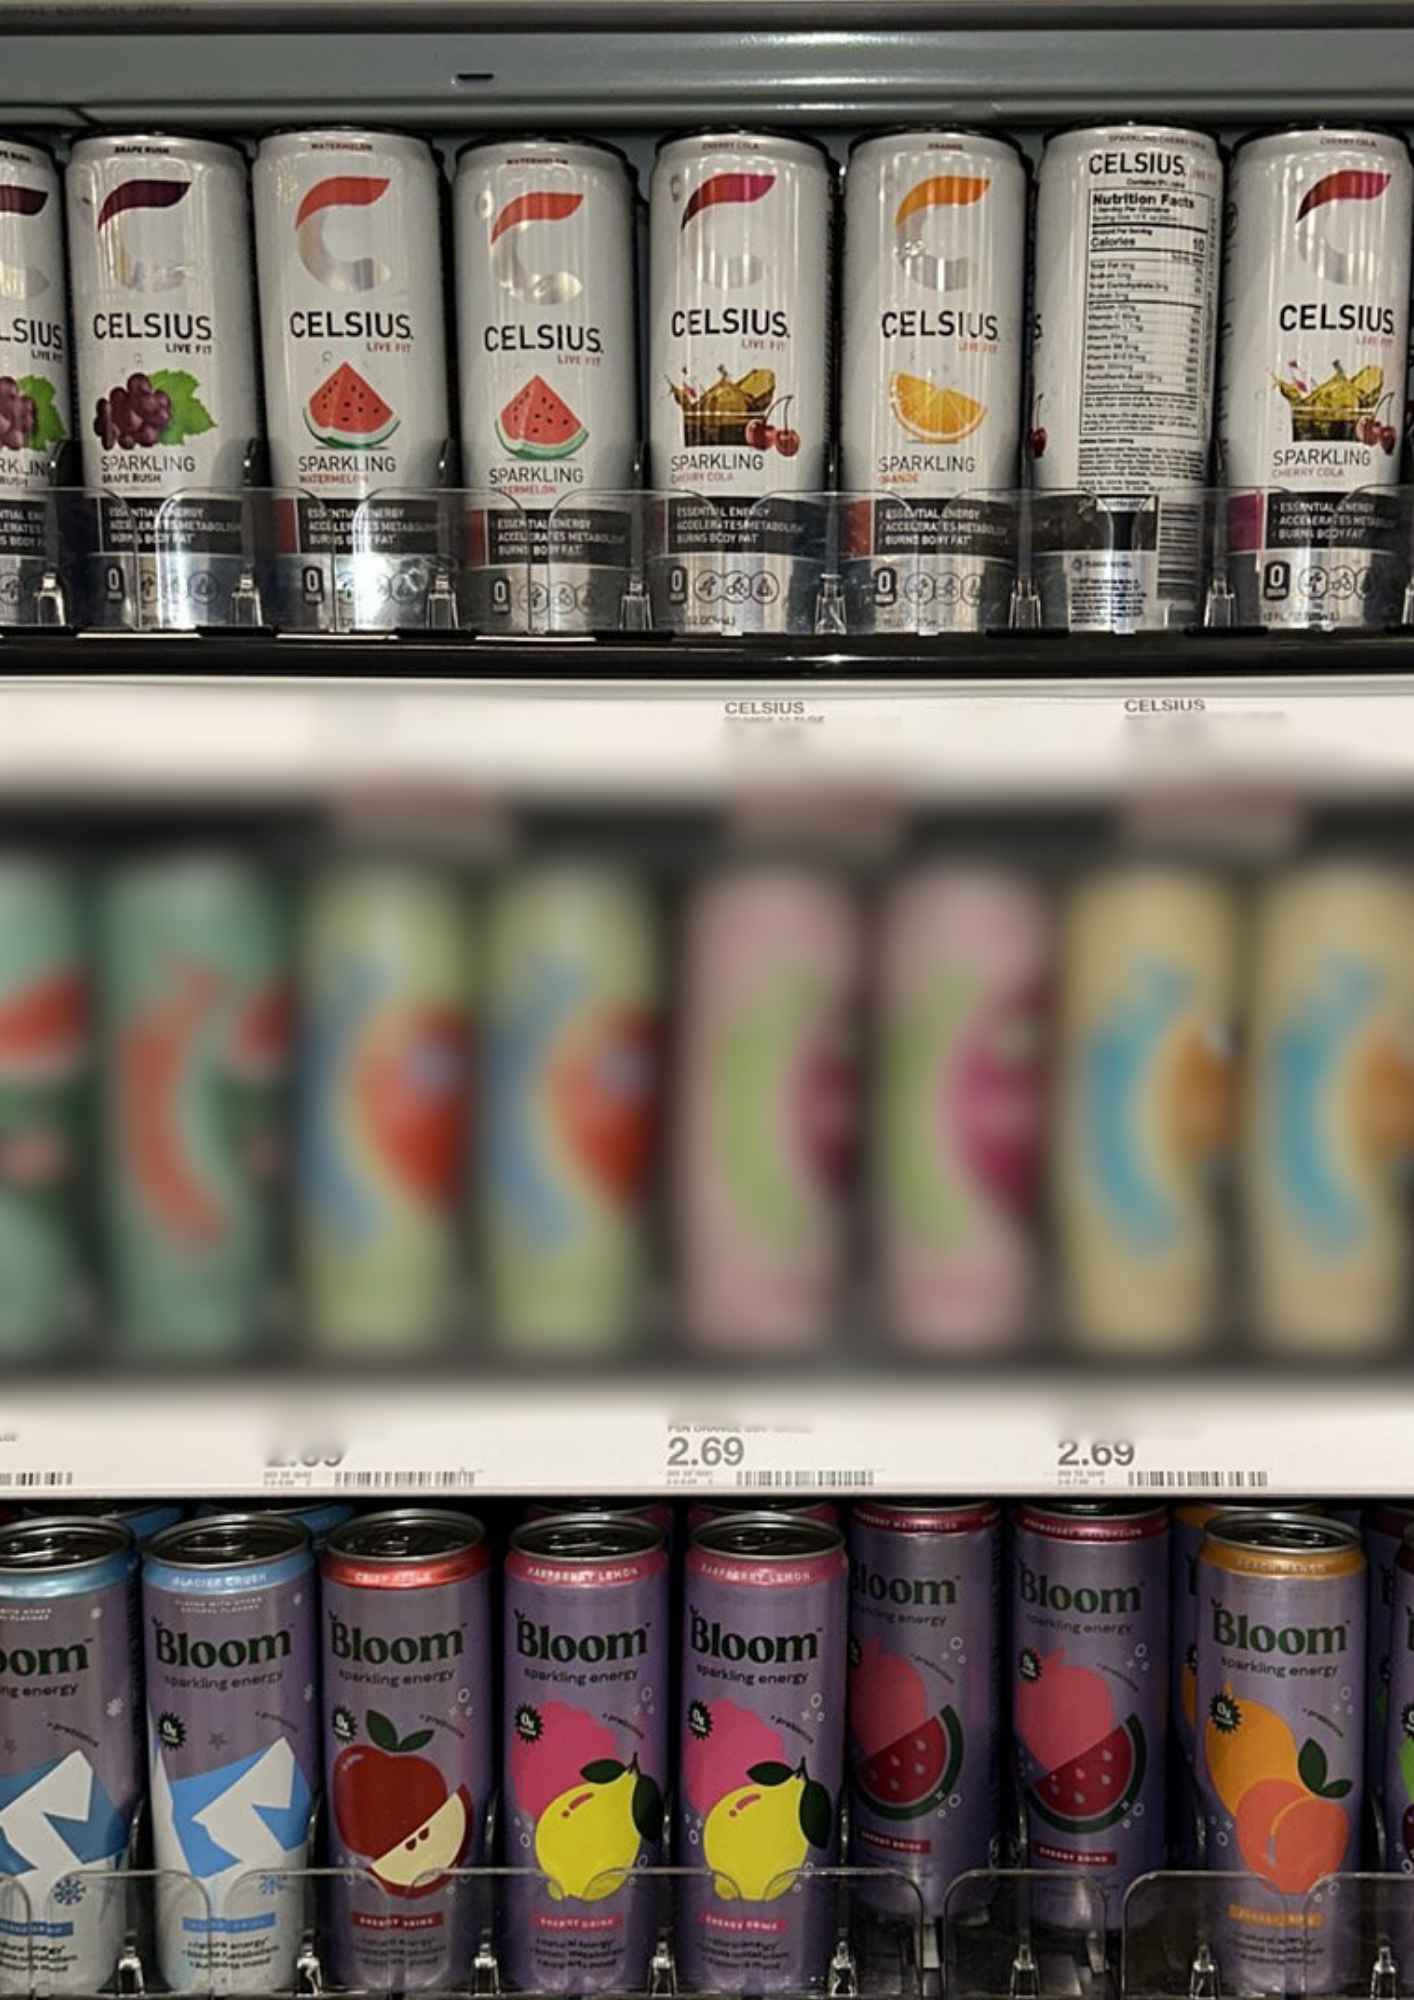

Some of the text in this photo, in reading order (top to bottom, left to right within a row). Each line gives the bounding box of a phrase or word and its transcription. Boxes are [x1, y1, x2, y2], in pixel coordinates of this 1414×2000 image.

[1089, 151, 1186, 177] CELSIUS
[1092, 193, 1157, 206] Nutrition
[93, 312, 213, 341] CELSIUS
[290, 311, 412, 340] CELSIUS
[671, 307, 788, 338] CELSIUS
[881, 310, 999, 342] CELSIUS
[1279, 303, 1395, 335] CELSIUS
[165, 342, 191, 354] LIVE
[366, 341, 391, 352] LIVE
[484, 324, 604, 354] CELSIUS
[557, 354, 582, 365] LIVE
[100, 454, 196, 472] SPARKLING
[297, 454, 397, 472] SPARKLING
[670, 453, 764, 472] SPARKLING
[878, 454, 976, 473] SPARKLING
[1272, 448, 1371, 467] SPARKLING
[488, 466, 584, 485] SPARKLING
[1271, 467, 1345, 479] CHERRY COLA
[1279, 501, 1335, 514] ESSENTIAL
[108, 568, 120, 591] 0
[305, 567, 319, 592] 0
[671, 569, 682, 592] 0
[878, 570, 892, 594] 0
[1269, 563, 1285, 589] 0
[493, 580, 508, 604] 0
[724, 701, 805, 715] CELSIUS
[1123, 698, 1206, 712] CELSIUS
[667, 1436, 745, 1467] 2.69
[1057, 1439, 1136, 1467] 2.69
[597, 1567, 639, 1582] LEMON
[1019, 1566, 1142, 1614] Bloom
[330, 1615, 466, 1665] Bloom
[516, 1614, 648, 1663] Bloom
[690, 1610, 820, 1664] Bloom
[1083, 1622, 1133, 1636] energy
[1212, 1602, 1349, 1656] Bloom
[155, 1620, 293, 1668] Bloom
[339, 1668, 456, 1688] sparkling energy
[524, 1666, 640, 1686] sparkling energy
[696, 1663, 809, 1686] sparkling energy
[1220, 1655, 1341, 1680] sparkling energy
[22, 1682, 79, 1698] energy
[164, 1670, 285, 1692] sparkling energy
